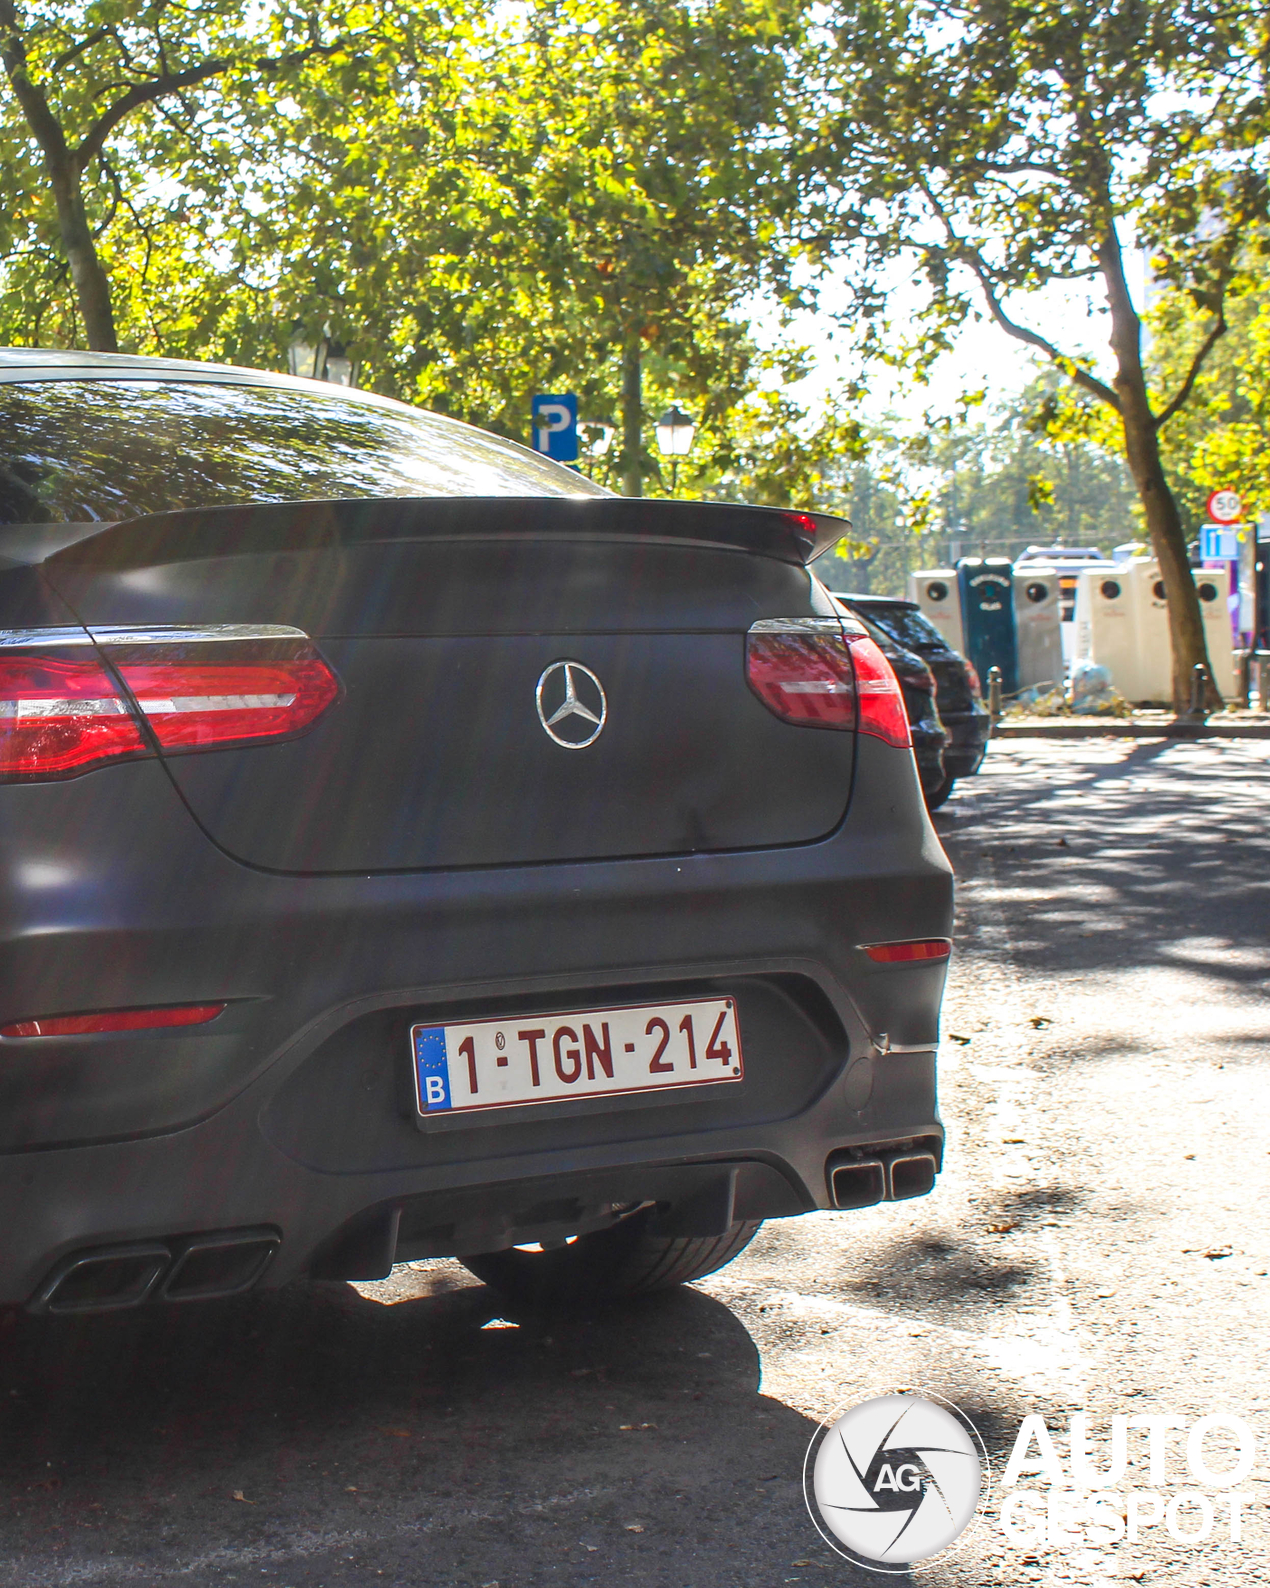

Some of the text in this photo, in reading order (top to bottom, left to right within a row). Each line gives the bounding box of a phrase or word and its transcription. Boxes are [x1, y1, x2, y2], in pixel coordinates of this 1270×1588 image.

[538, 404, 571, 452] P
[1216, 497, 1237, 510] 50
[425, 1076, 446, 1104] B
